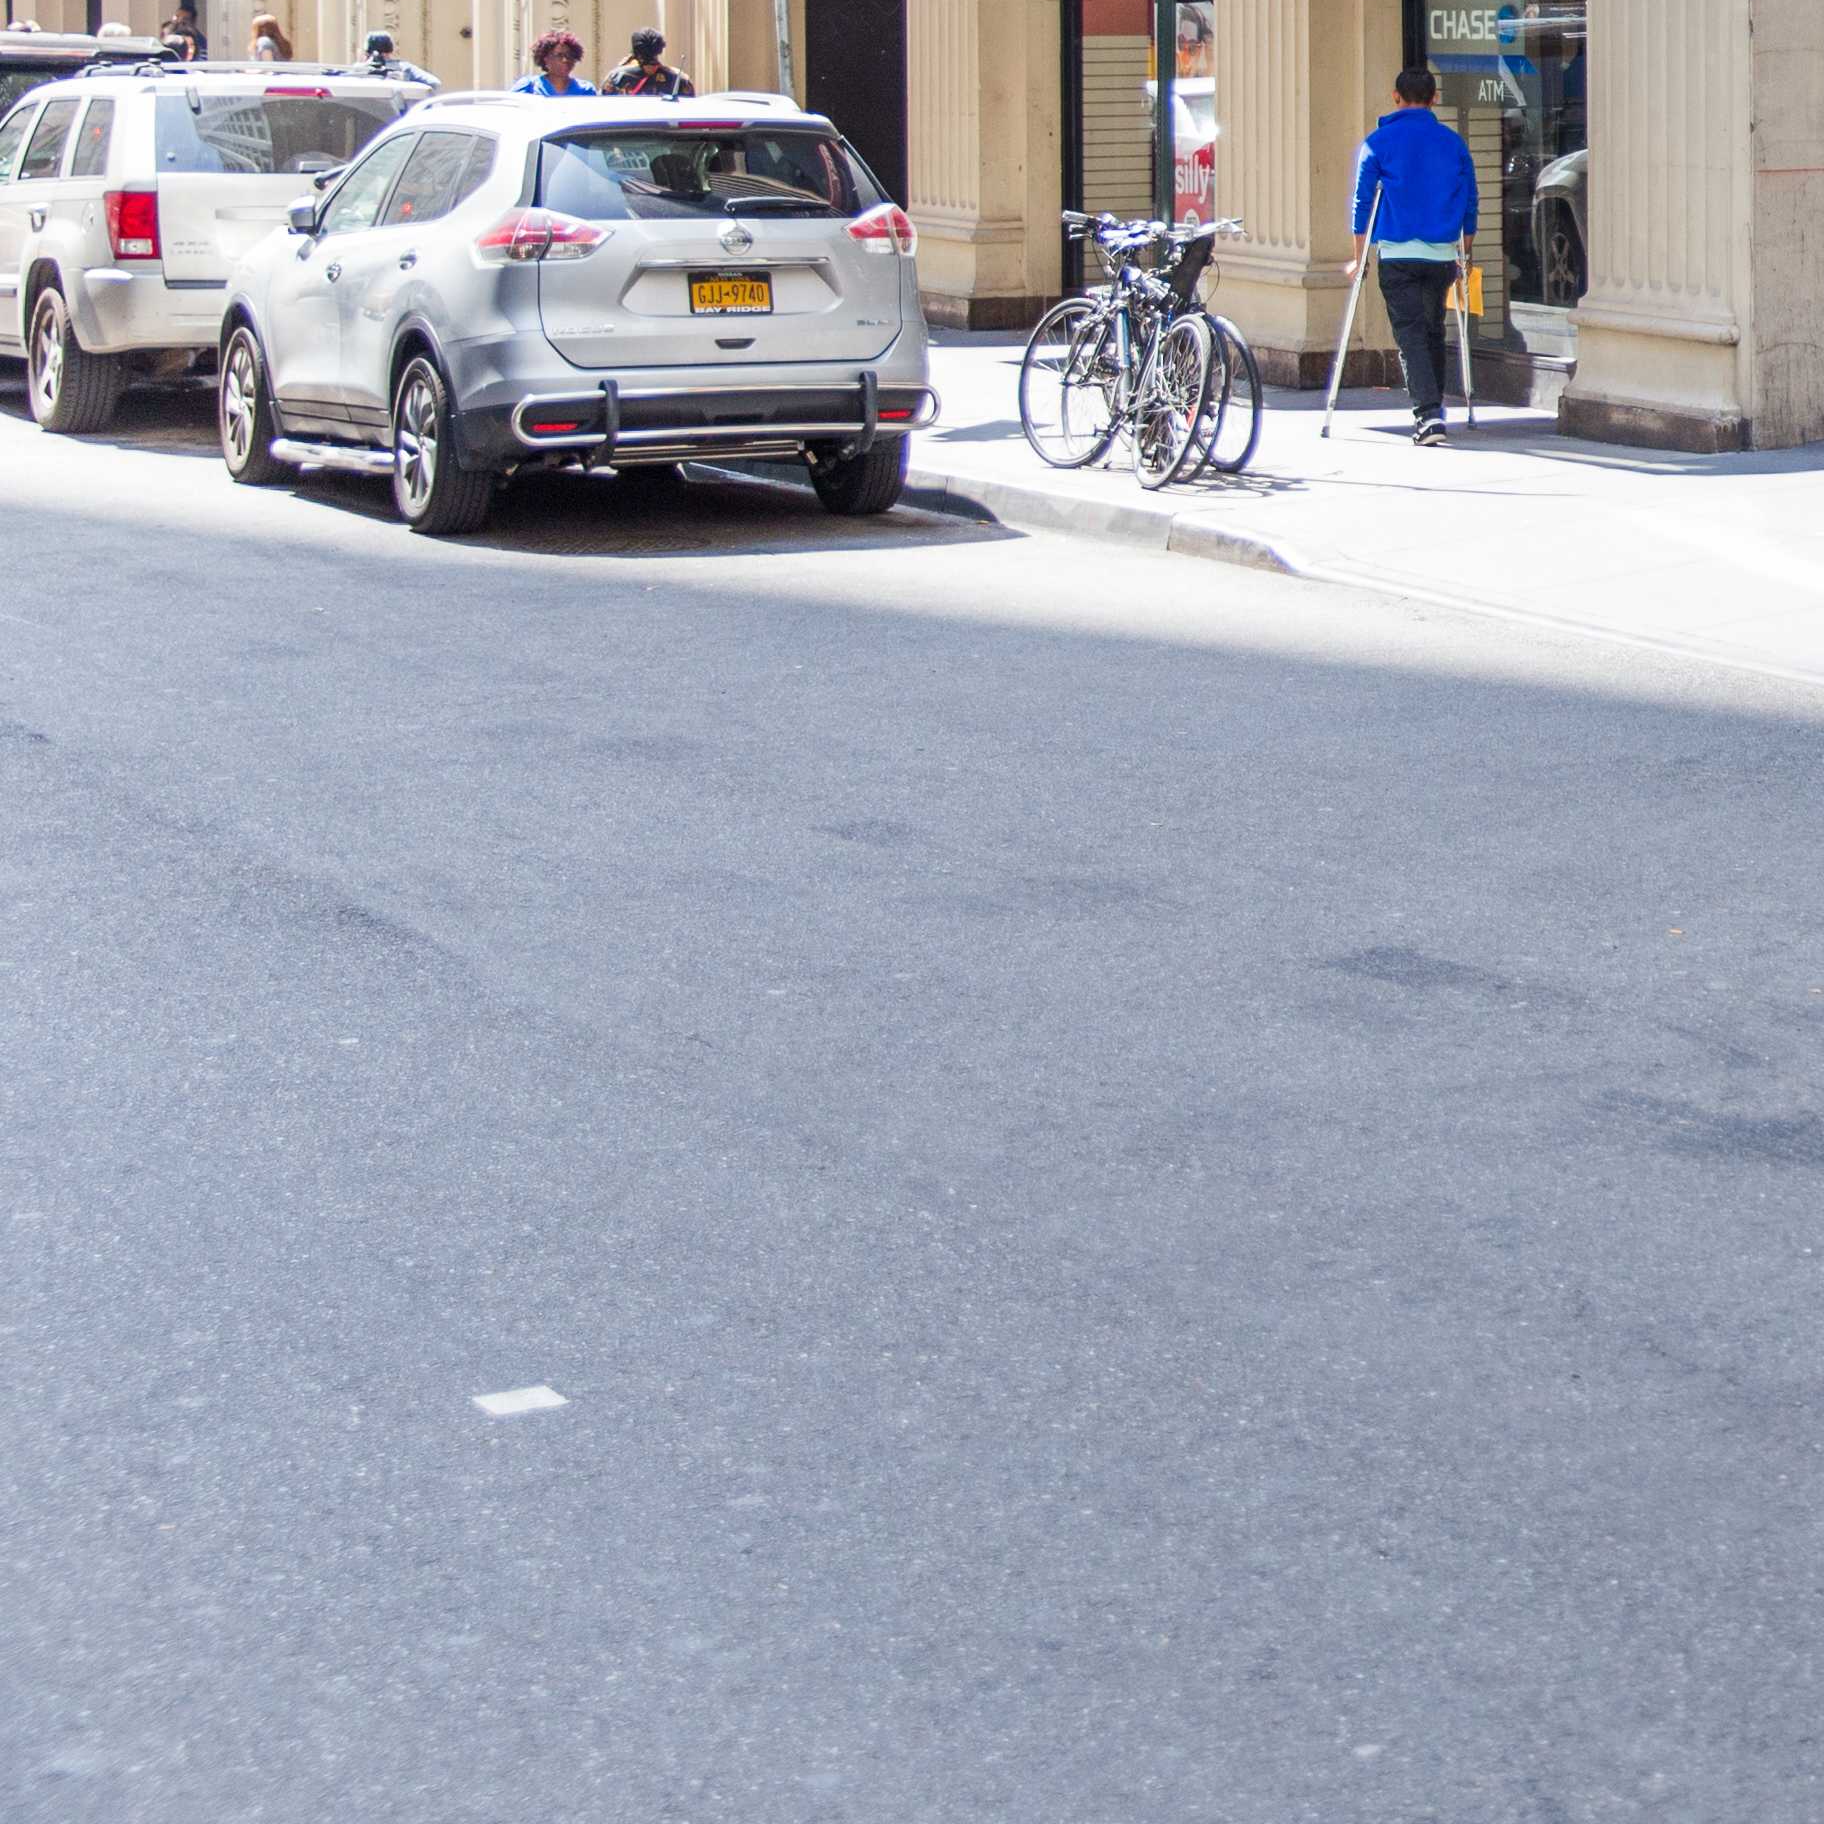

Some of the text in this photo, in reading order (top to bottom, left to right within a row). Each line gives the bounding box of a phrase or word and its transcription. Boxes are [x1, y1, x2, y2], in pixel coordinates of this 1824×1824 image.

[1430, 9, 1497, 40] CHASE
[1478, 79, 1504, 102] ATM
[695, 305, 771, 314] BAY RIDGE
